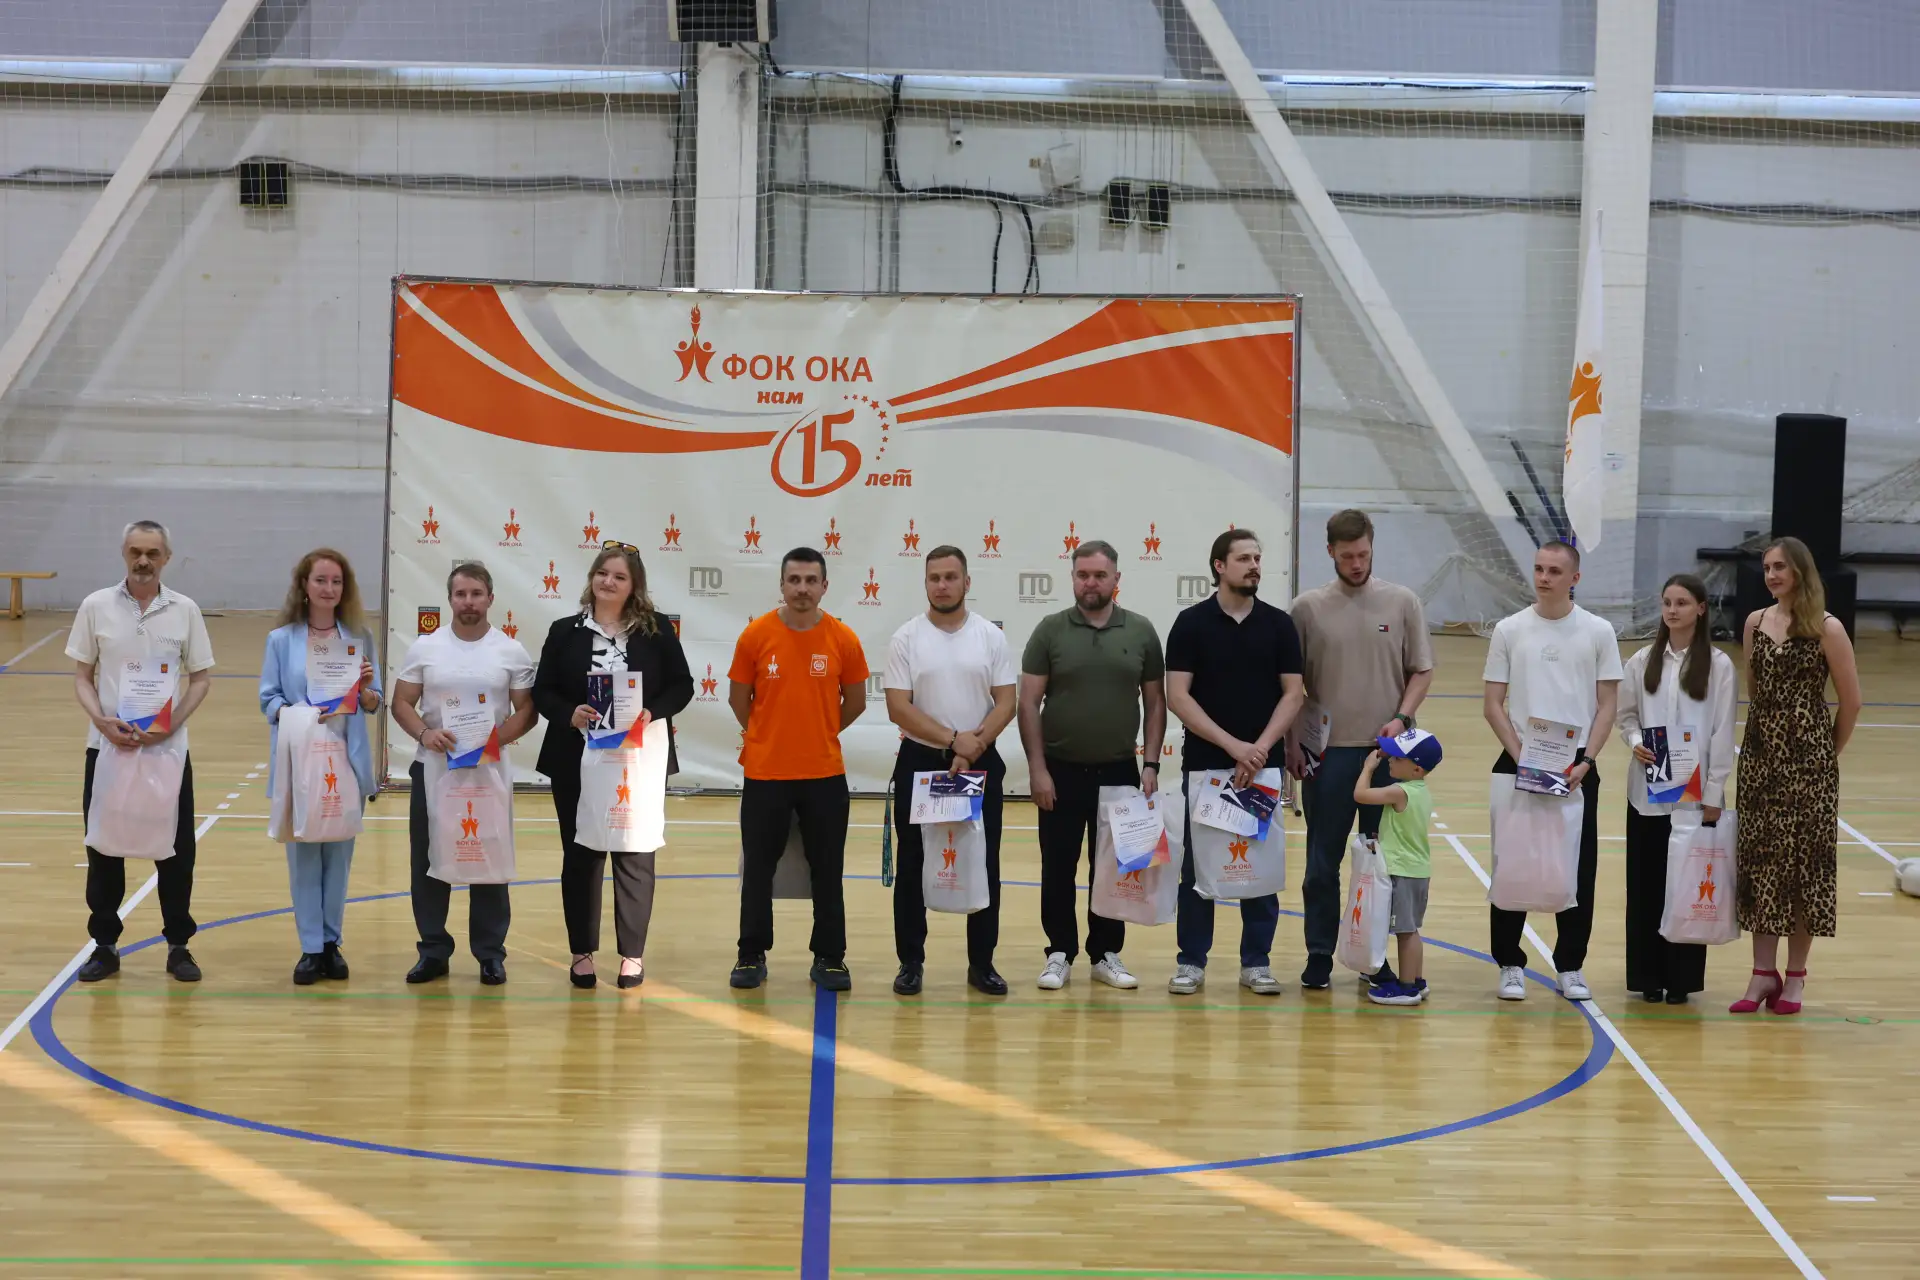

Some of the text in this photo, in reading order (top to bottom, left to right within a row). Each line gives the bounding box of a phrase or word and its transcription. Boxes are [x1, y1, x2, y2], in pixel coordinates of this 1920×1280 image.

[722, 353, 873, 382] ФОК ОКА
[757, 391, 804, 404] нам
[795, 408, 861, 496] 15
[865, 469, 912, 487] лет
[690, 566, 722, 589] ГТО
[1019, 574, 1052, 595] ГТО
[1177, 576, 1210, 597] ГТО
